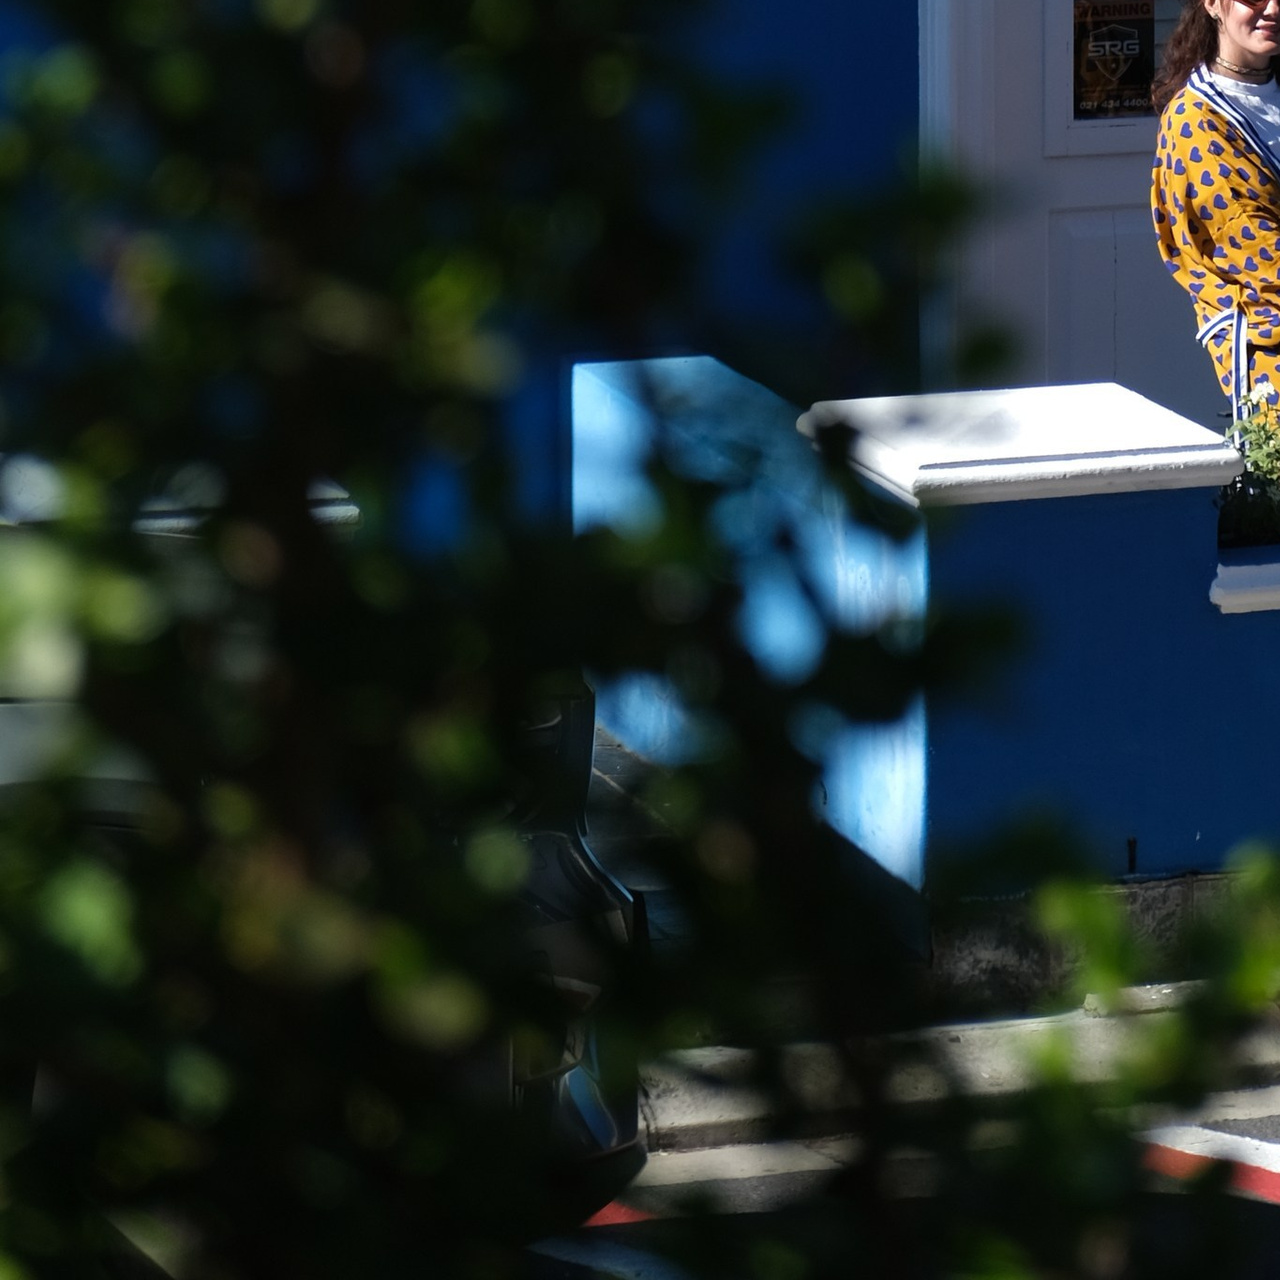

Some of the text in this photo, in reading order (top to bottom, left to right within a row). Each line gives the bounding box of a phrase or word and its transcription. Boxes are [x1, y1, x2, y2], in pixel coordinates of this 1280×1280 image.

[1076, 2, 1150, 18] WARNING
[1088, 39, 1140, 57] SRG
[1080, 100, 1098, 109] 021
